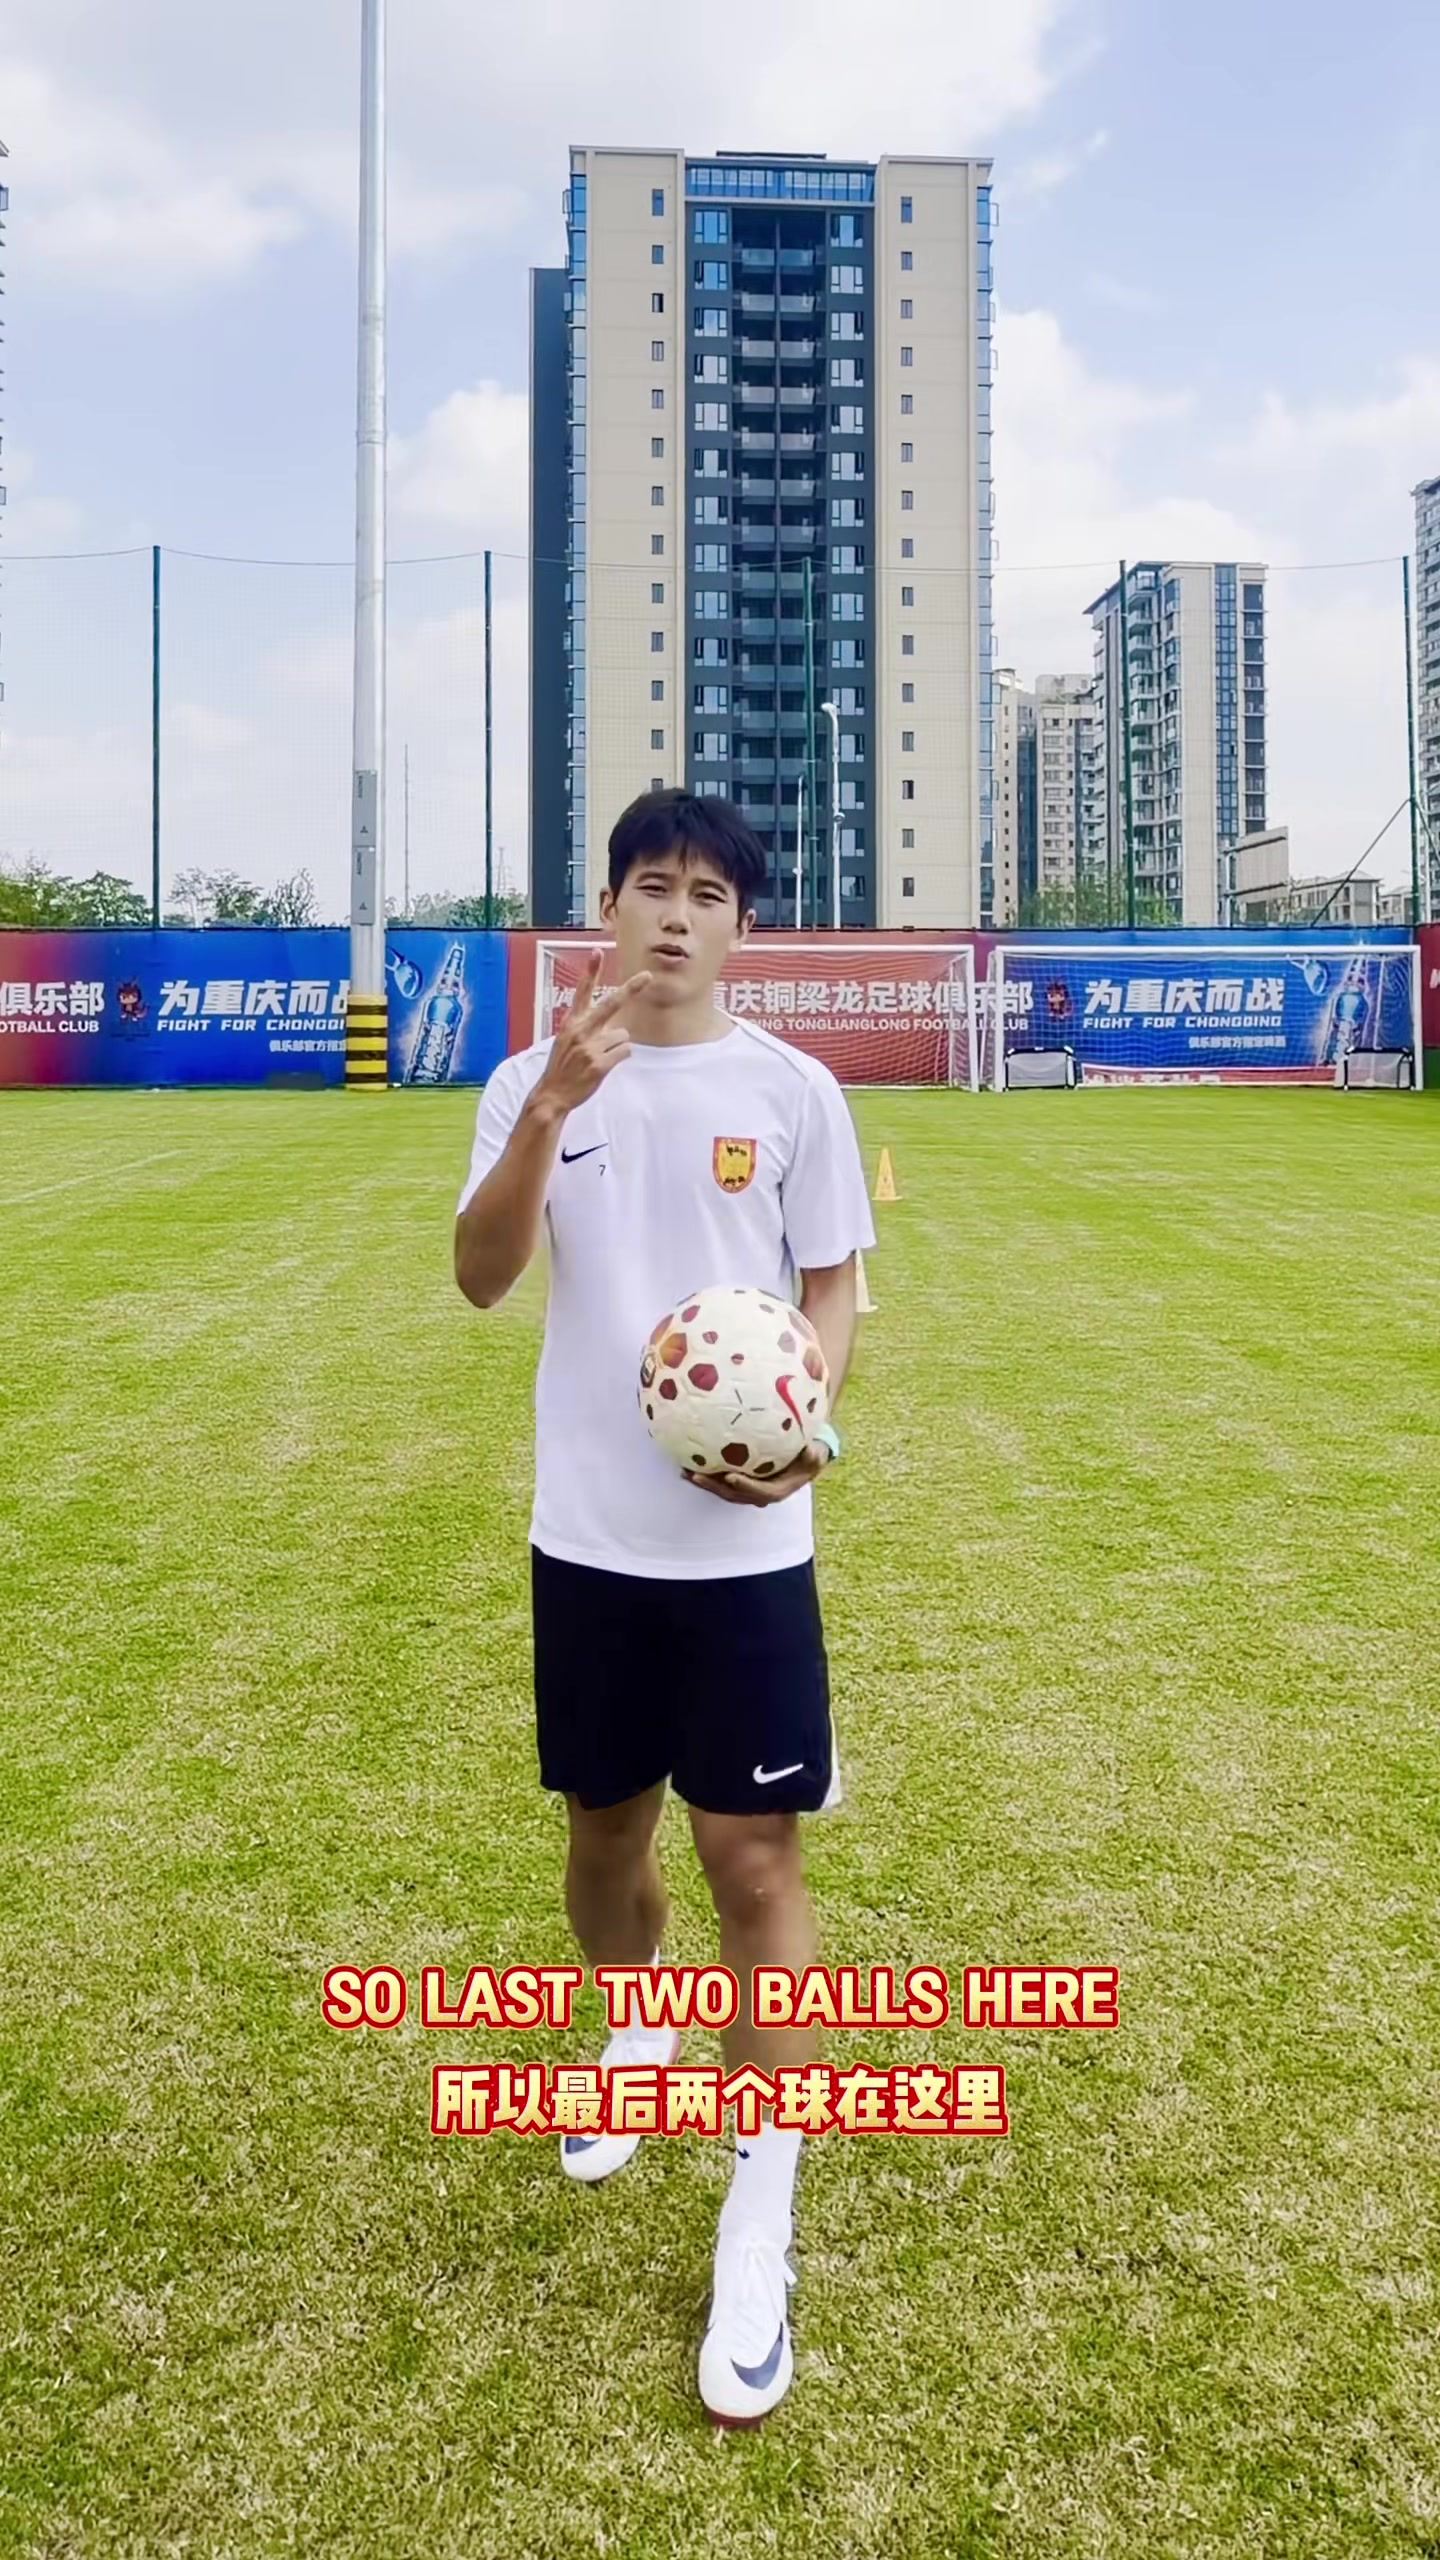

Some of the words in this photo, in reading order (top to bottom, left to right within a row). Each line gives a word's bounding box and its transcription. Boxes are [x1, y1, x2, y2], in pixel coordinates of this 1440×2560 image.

[0, 981, 104, 1016] 俱乐部
[1084, 978, 1285, 1013] 为重庆而战
[58, 1020, 99, 1032] CLUB
[157, 1019, 210, 1031] FIGHT
[220, 1019, 256, 1031] FOR
[785, 1018, 911, 1031] TONGLIANGLONG
[1083, 1017, 1133, 1029] FIGHT
[1143, 1016, 1176, 1028] FOR
[1184, 1015, 1282, 1028] CHONGQING
[598, 1164, 606, 1176] 7
